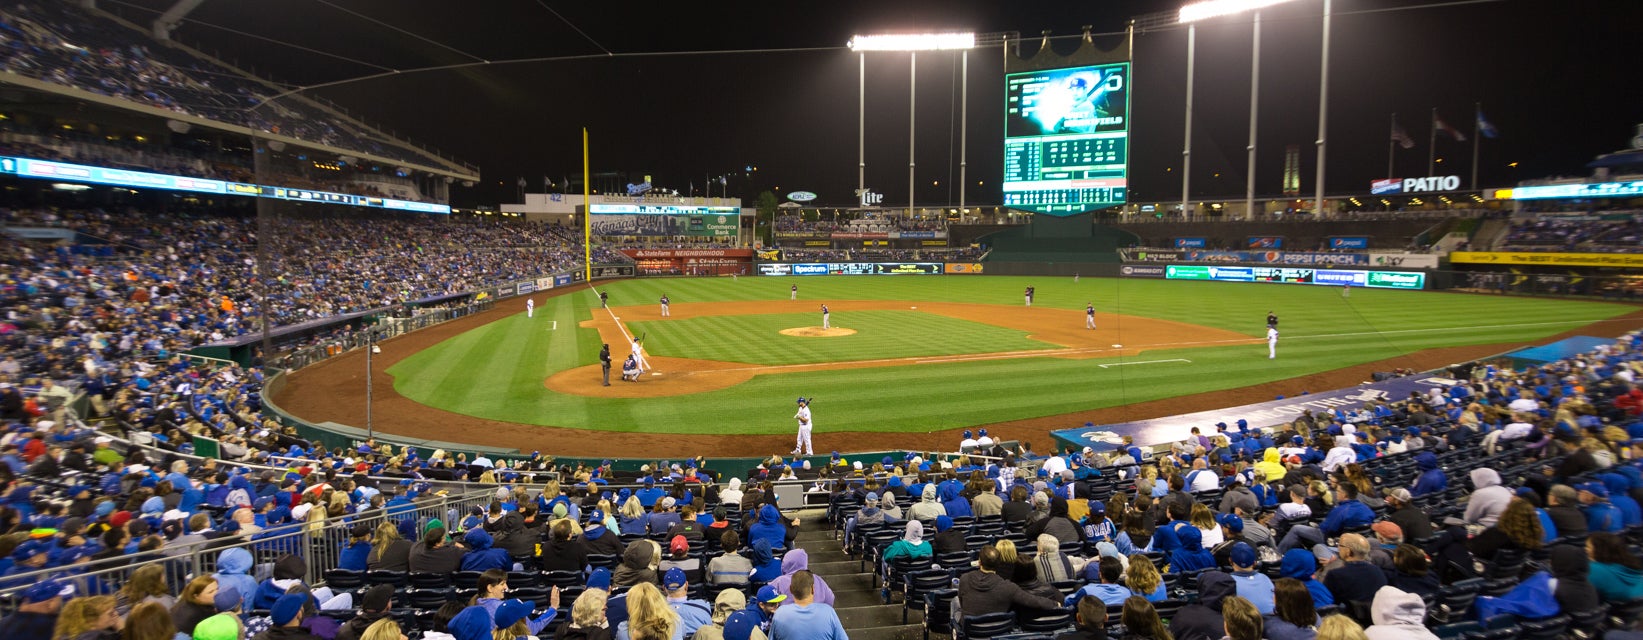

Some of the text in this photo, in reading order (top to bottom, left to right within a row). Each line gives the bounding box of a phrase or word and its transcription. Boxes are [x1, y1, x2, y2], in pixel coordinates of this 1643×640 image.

[1403, 175, 1460, 193] PATIO
[550, 192, 561, 202] 42
[862, 191, 884, 206] Lite
[591, 214, 658, 235] Kansas City
[1284, 253, 1353, 263] PEPSI PORCH
[794, 265, 826, 274] Spectrum
[1316, 274, 1353, 282] UNITED
